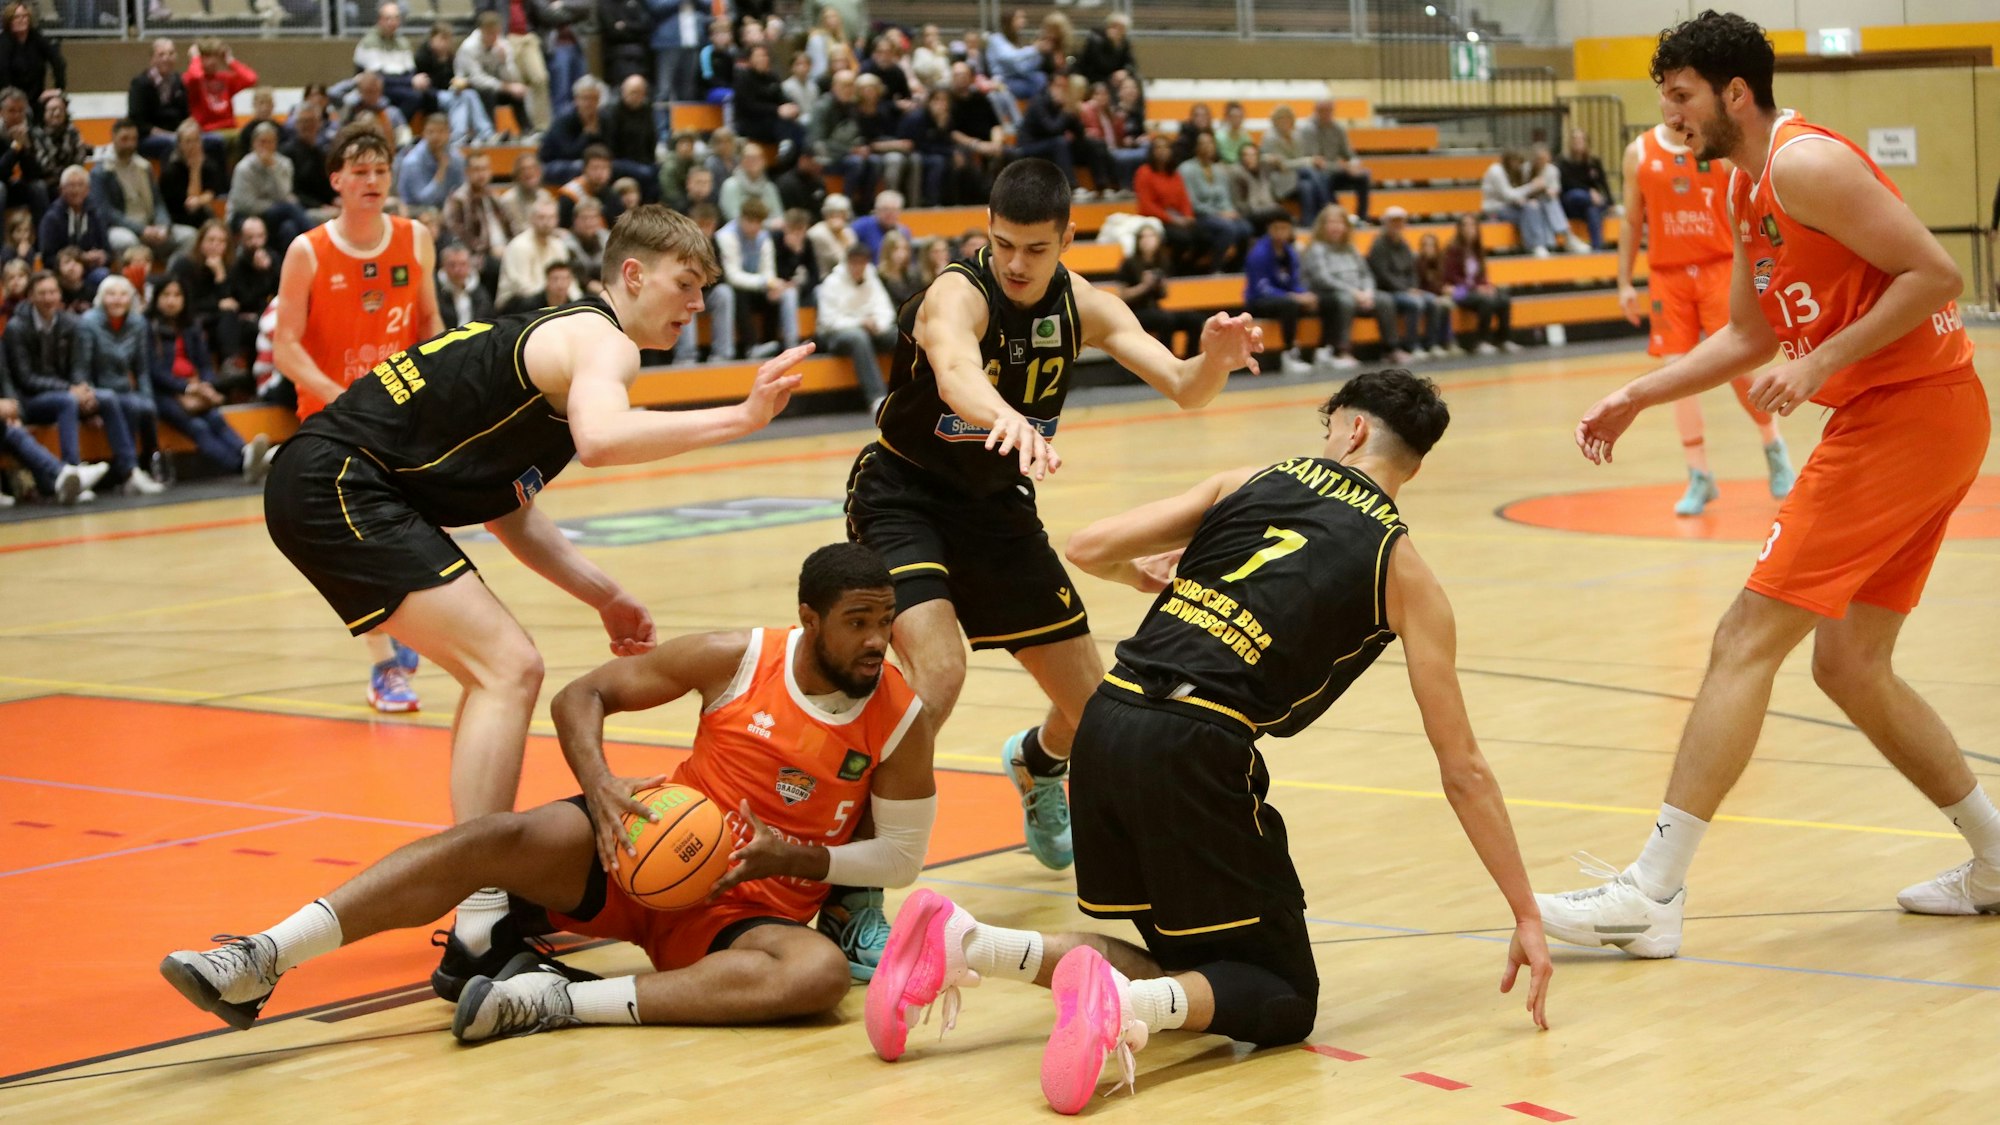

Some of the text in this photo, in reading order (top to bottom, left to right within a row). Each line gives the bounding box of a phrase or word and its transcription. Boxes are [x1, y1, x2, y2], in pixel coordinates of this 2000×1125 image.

[1700, 187, 1714, 208] 7
[1774, 281, 1820, 328] 13
[396, 357, 426, 393] BBA
[1023, 356, 1065, 404] 12
[1277, 458, 1400, 530] SANTANA M.
[1220, 524, 1309, 583] 7
[1232, 608, 1273, 651] BBA
[825, 800, 855, 837] 5
[678, 836, 704, 863] FIBA
